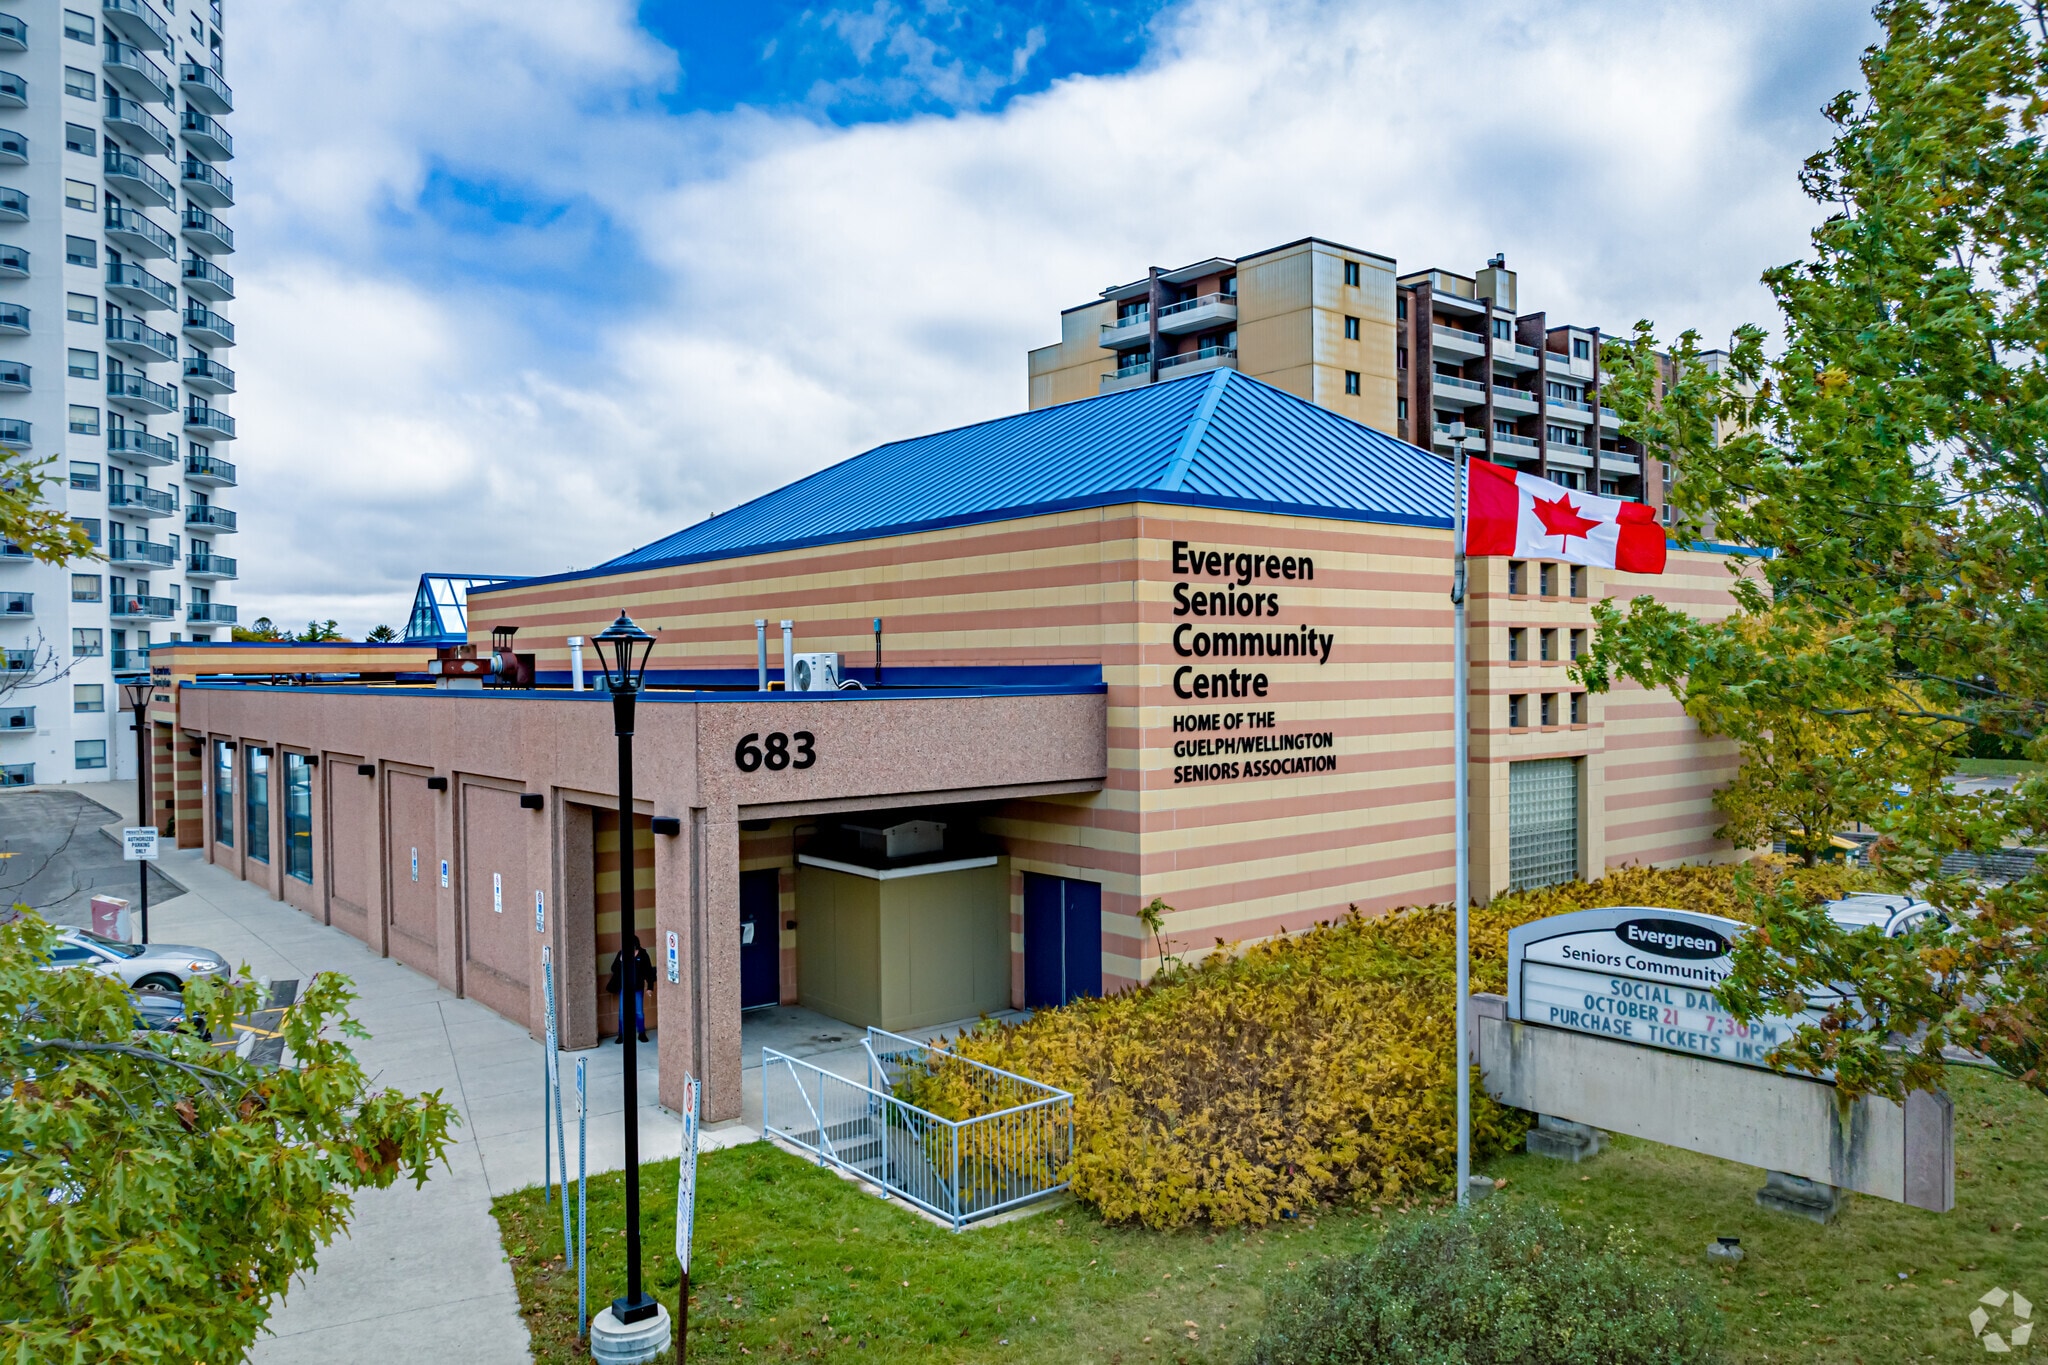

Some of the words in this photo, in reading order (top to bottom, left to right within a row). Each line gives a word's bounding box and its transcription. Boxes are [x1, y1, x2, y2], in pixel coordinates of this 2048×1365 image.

[1172, 541, 1314, 586] Evergreen
[1173, 582, 1279, 617] Seniors
[1173, 623, 1334, 665] Community
[1173, 666, 1268, 699] Centre
[1173, 714, 1220, 733] HOME
[1223, 713, 1244, 730] OF
[1247, 712, 1275, 728] THE
[735, 731, 817, 773] 683
[1174, 732, 1333, 758] GUELPH/WELLINGTON
[1174, 761, 1240, 783] SENIORS
[1243, 755, 1336, 778] ASSOCIATION
[1628, 924, 1717, 952] Evergreen
[1562, 945, 1621, 968] Seniors
[1625, 954, 1728, 983] Community
[1584, 994, 1658, 1022] OCTOBER
[1663, 1008, 1678, 1026] 21
[1611, 979, 1673, 1005] SOCIAL
[1686, 991, 1730, 1015] DAN
[1550, 1007, 1633, 1037] PURCHASE
[1648, 1025, 1720, 1053] TICKETS
[1736, 1041, 1766, 1063] INS
